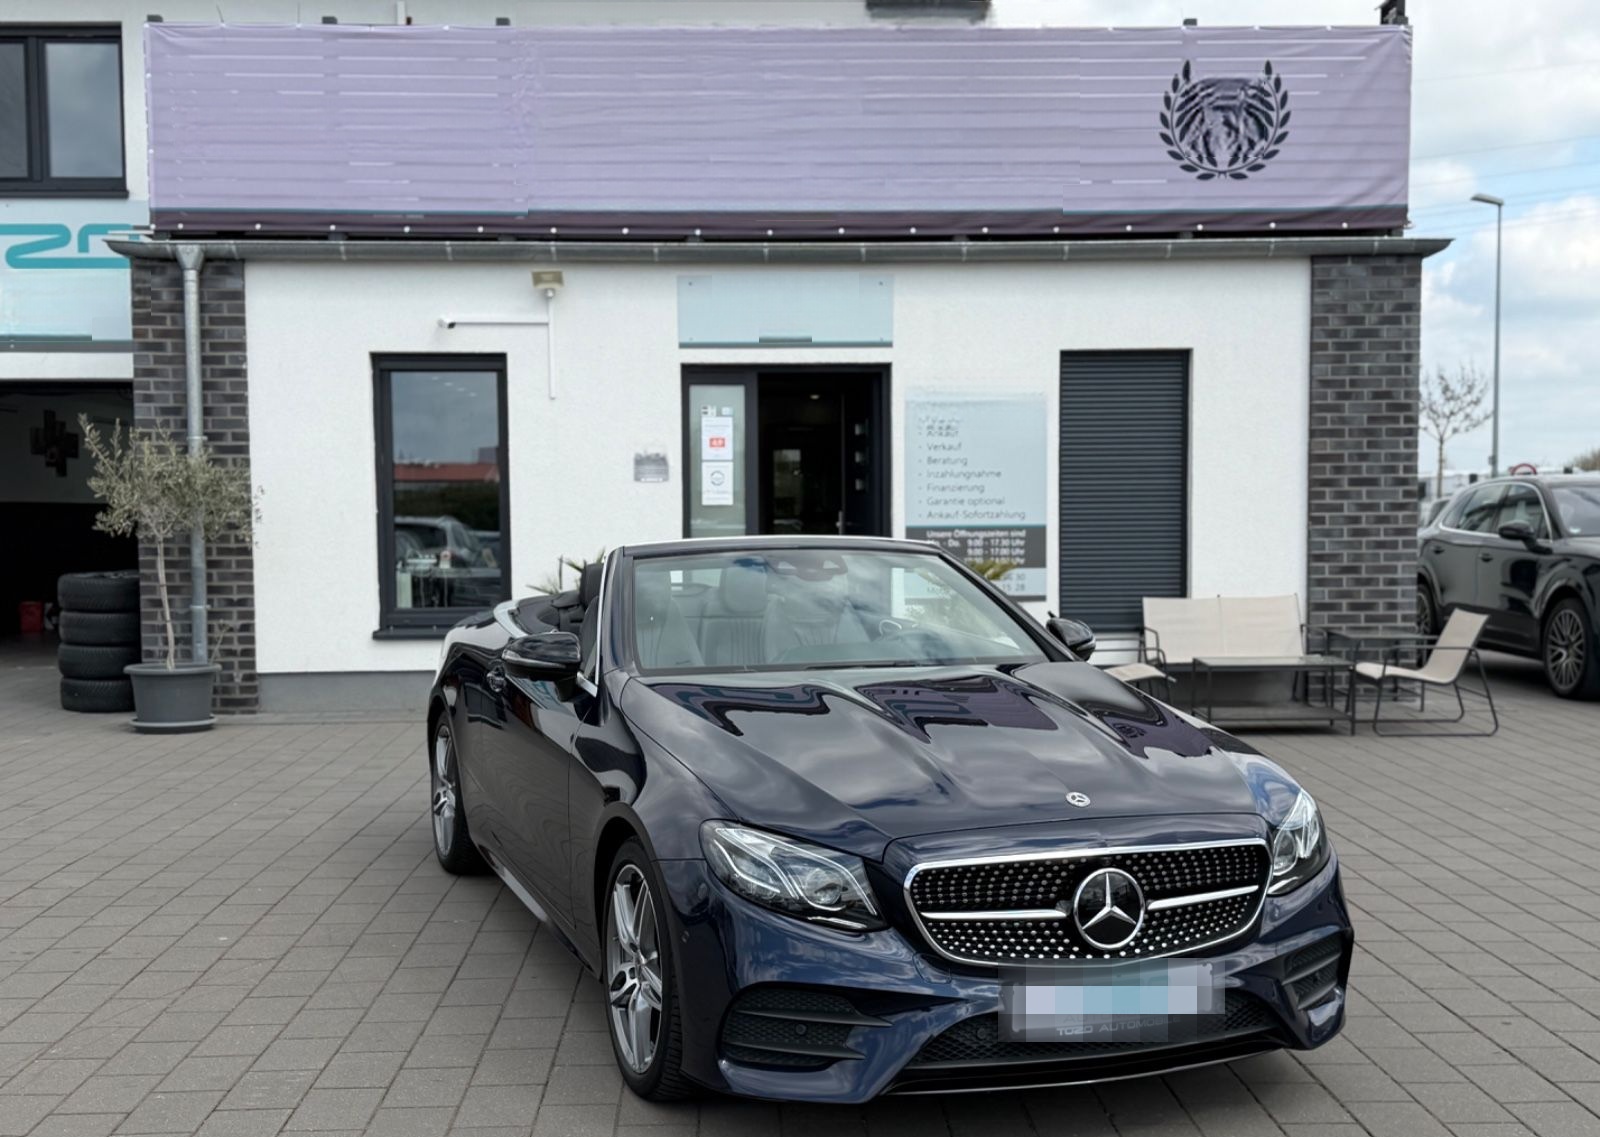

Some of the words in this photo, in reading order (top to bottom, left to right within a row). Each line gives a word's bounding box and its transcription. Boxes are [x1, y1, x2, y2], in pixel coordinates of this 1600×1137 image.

[926, 441, 962, 451] Verkauf
[926, 456, 968, 467] Beratung
[926, 469, 1002, 480] Inzahlungnahme
[926, 483, 985, 494] Finanzierung
[926, 496, 965, 506] Garantie
[967, 496, 1006, 507] optional
[926, 530, 952, 538] Unsere
[953, 529, 1008, 540] Öffnungszeiten
[1010, 529, 1026, 538] sind
[1011, 538, 1026, 547] Uhr
[1011, 547, 1026, 556] Uhr
[1056, 1025, 1094, 1036] TOZO
